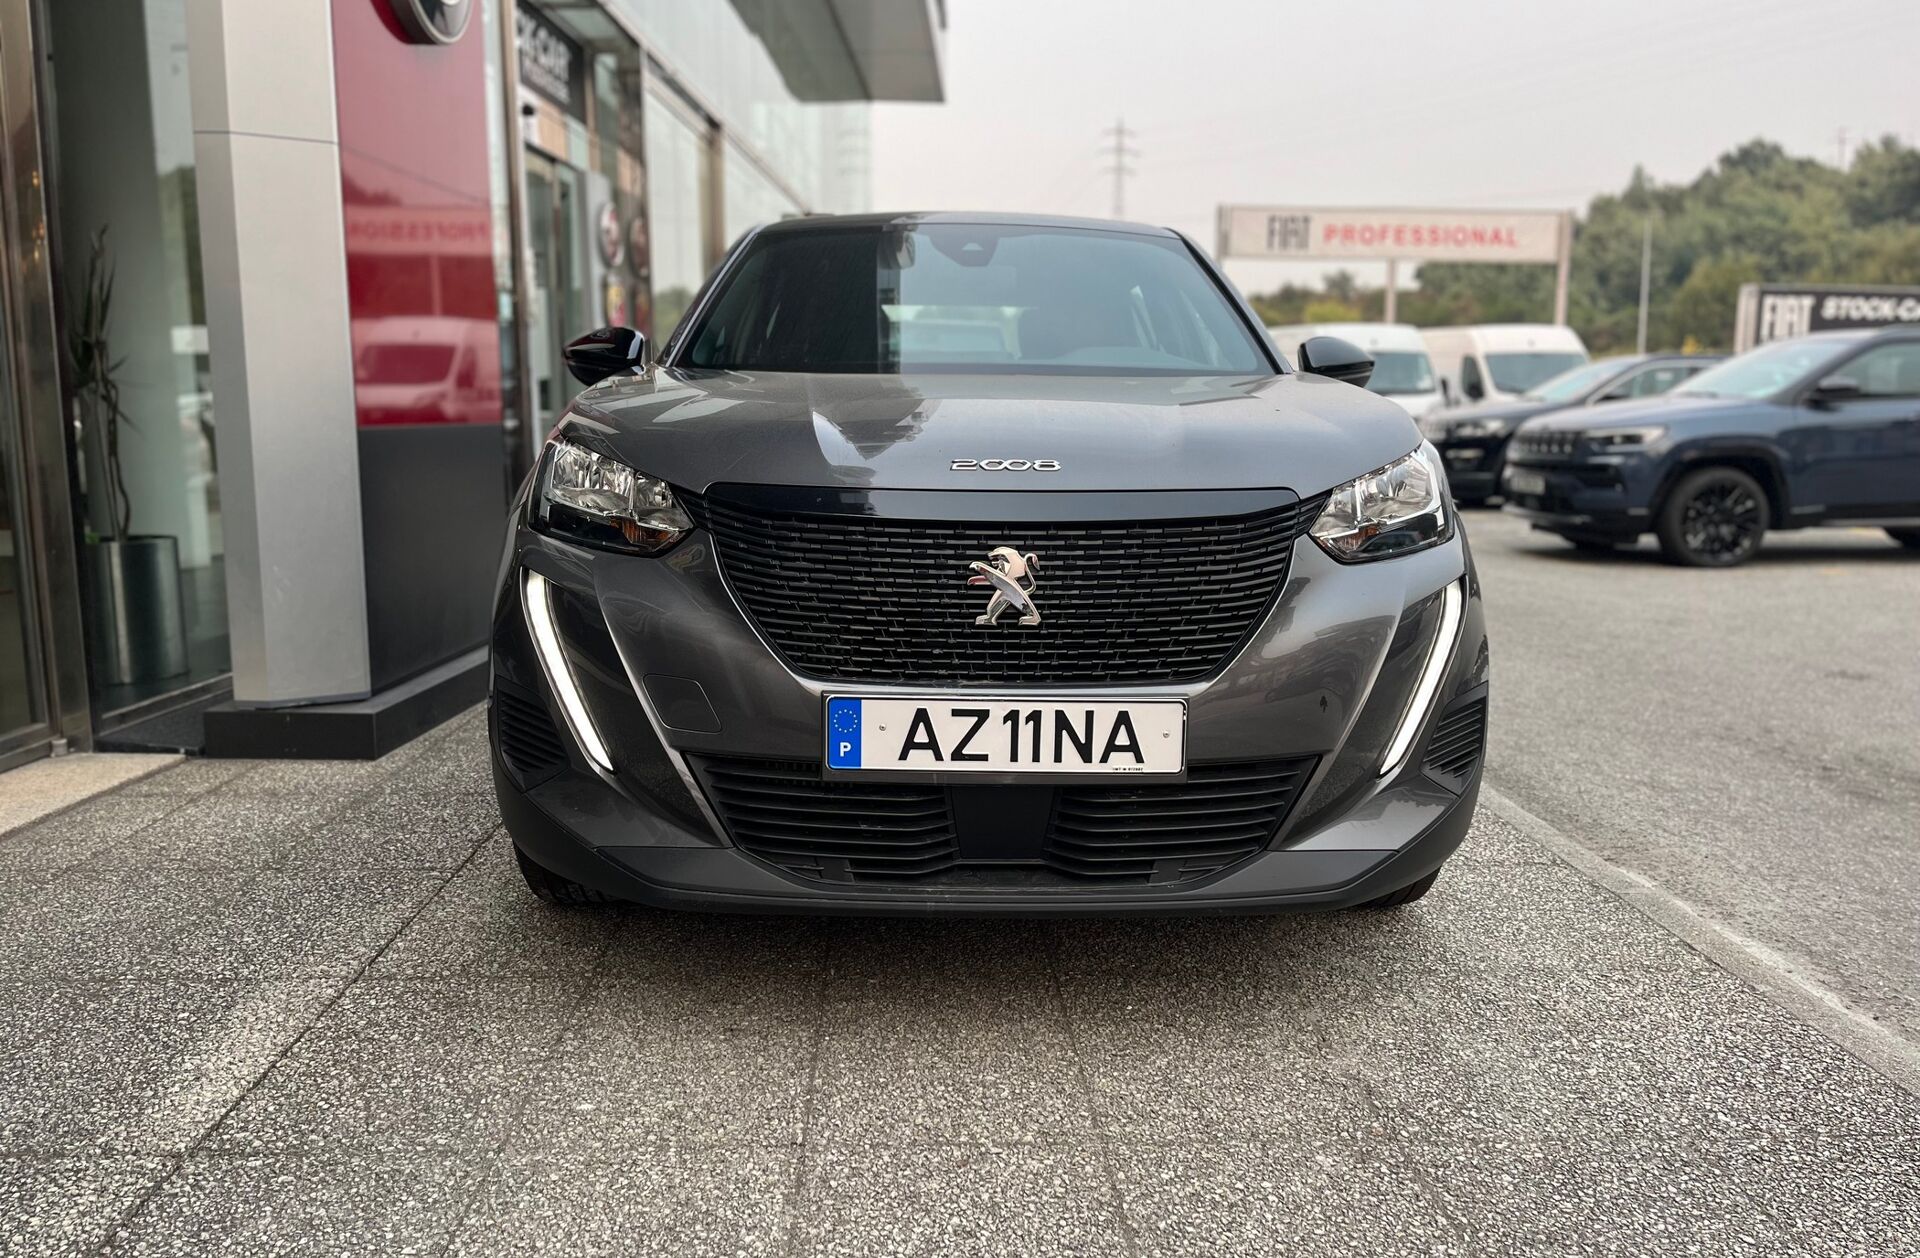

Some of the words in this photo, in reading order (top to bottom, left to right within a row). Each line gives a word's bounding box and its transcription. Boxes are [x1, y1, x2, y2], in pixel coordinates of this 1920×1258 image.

[1267, 216, 1311, 249] FIAT
[1323, 224, 1519, 247] PROFESSIONAL
[950, 459, 1062, 471] 2008
[839, 742, 851, 757] P
